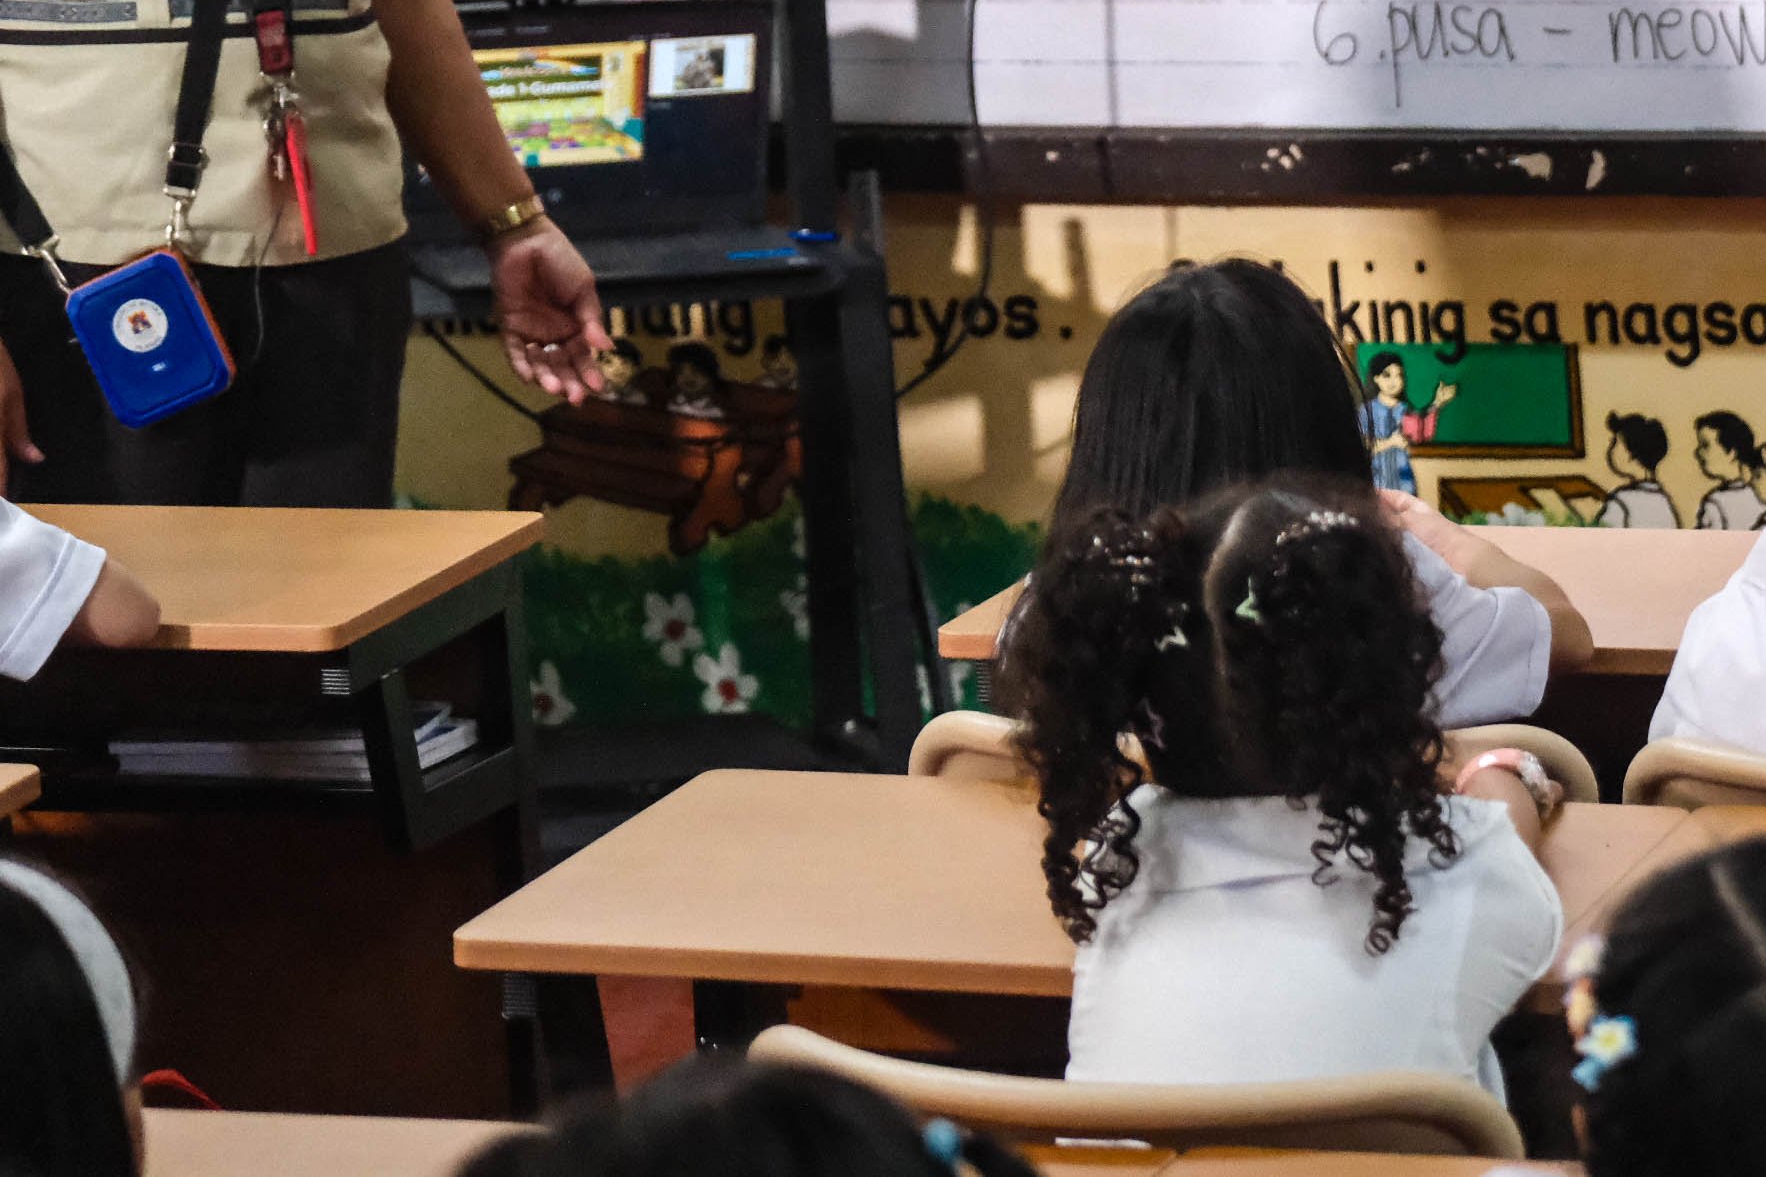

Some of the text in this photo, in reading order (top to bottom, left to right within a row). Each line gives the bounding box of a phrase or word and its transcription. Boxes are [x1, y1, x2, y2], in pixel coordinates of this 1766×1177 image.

[1386, 0, 1517, 109] pusa
[887, 293, 1074, 373] ayos.
[1326, 259, 1465, 365] kinig
[1488, 298, 1561, 344] sa
